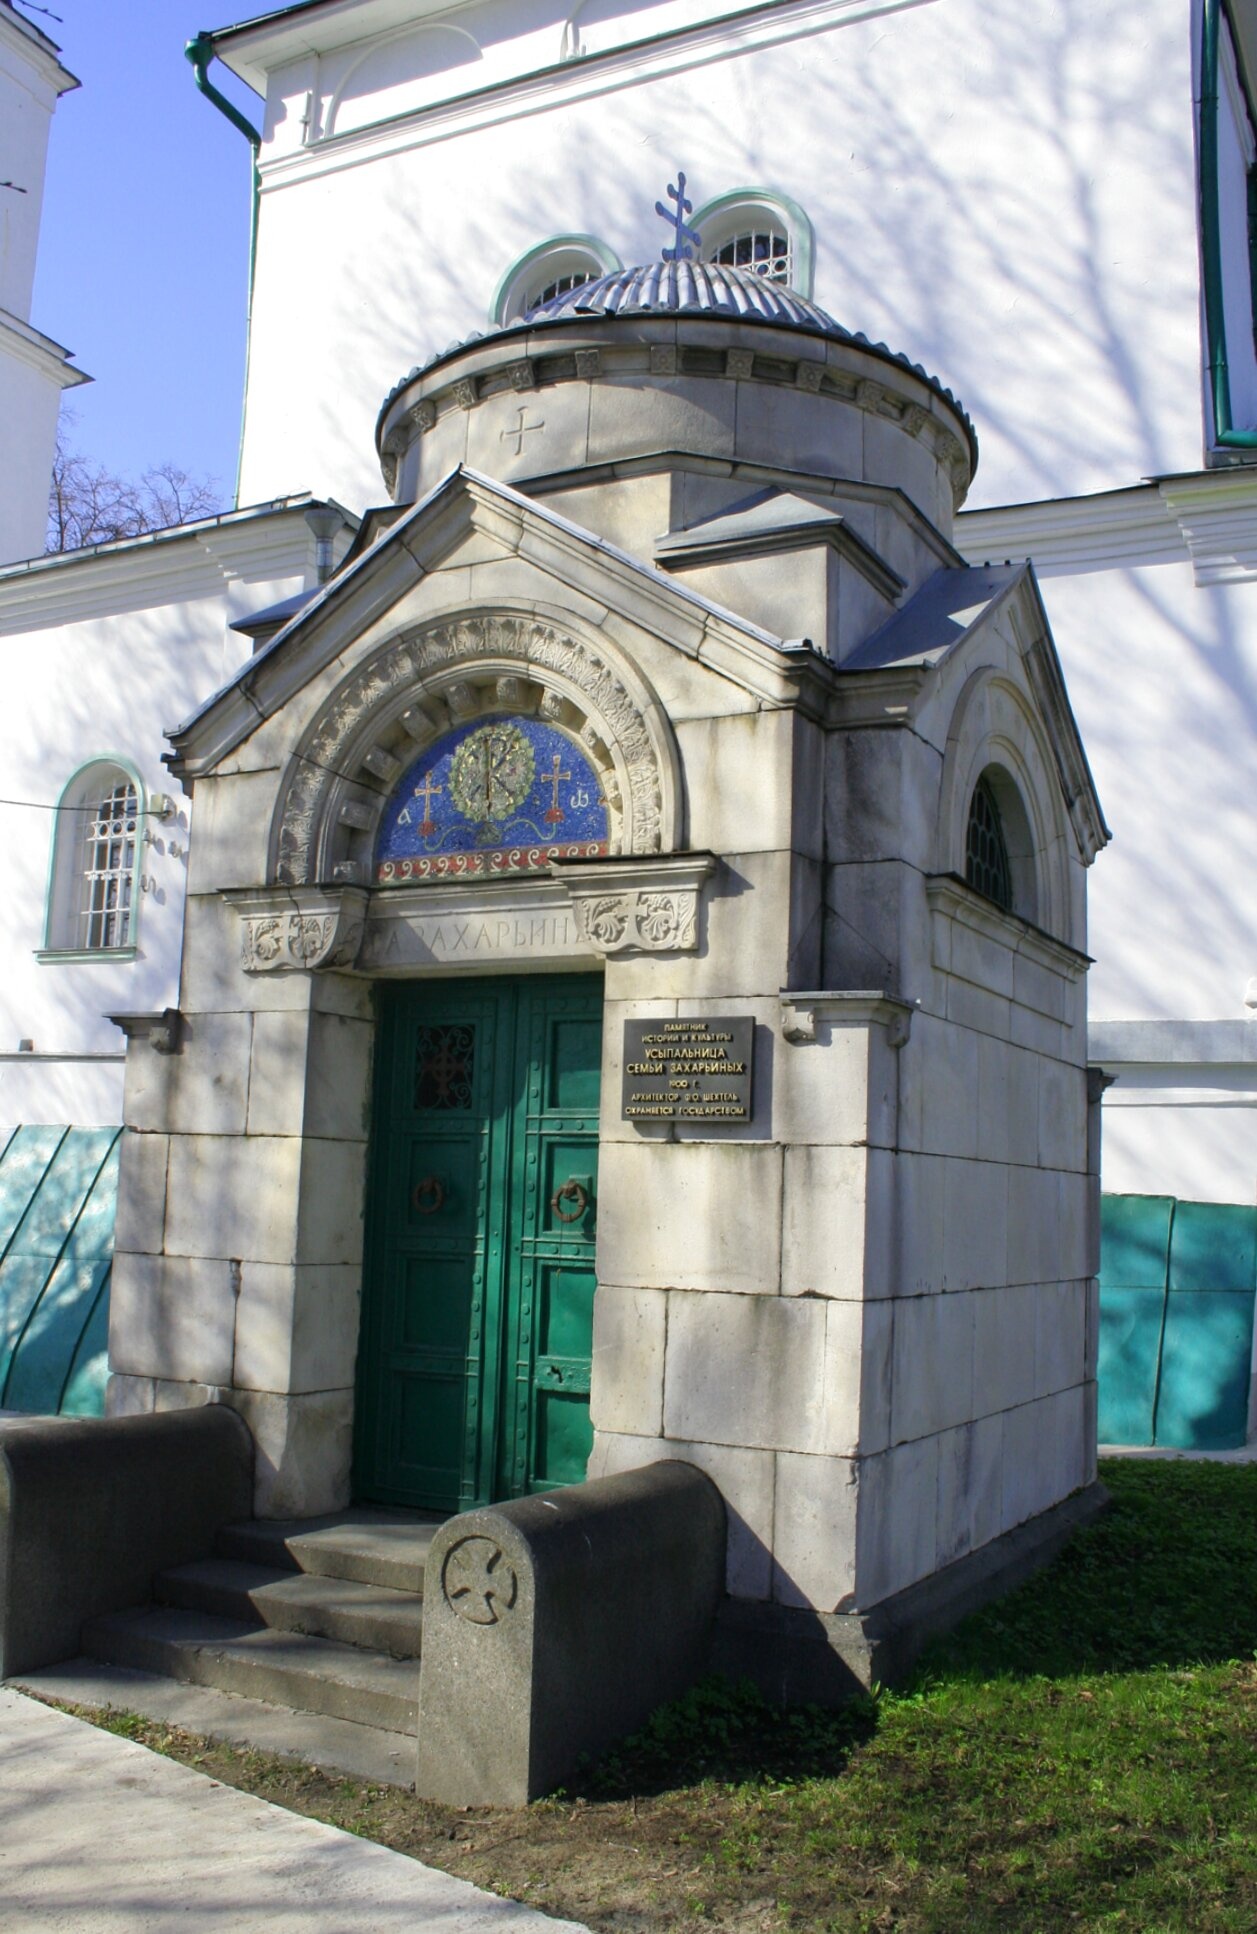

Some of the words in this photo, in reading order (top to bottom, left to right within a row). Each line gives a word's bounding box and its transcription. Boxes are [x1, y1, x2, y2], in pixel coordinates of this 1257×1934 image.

[664, 1023, 707, 1032] ПАМЯТНИК
[641, 1034, 679, 1043] ИСТОРИИ
[682, 1033, 688, 1042] И
[691, 1032, 732, 1041] КУЛЬТУРЫ
[645, 1048, 726, 1059] УСЫПАЛЬНИЦА
[626, 1063, 663, 1074] СЕМЬИ
[670, 1062, 744, 1073] ЗАХАРЬИНЫХ
[631, 1093, 679, 1102] АРХИТЕКТОР
[703, 1092, 738, 1101] ШЕХТЕЛЬ
[625, 1106, 673, 1115] ОХРАНЯЕТСЯ
[678, 1106, 744, 1115] ГОСУДАРСТВОМ
